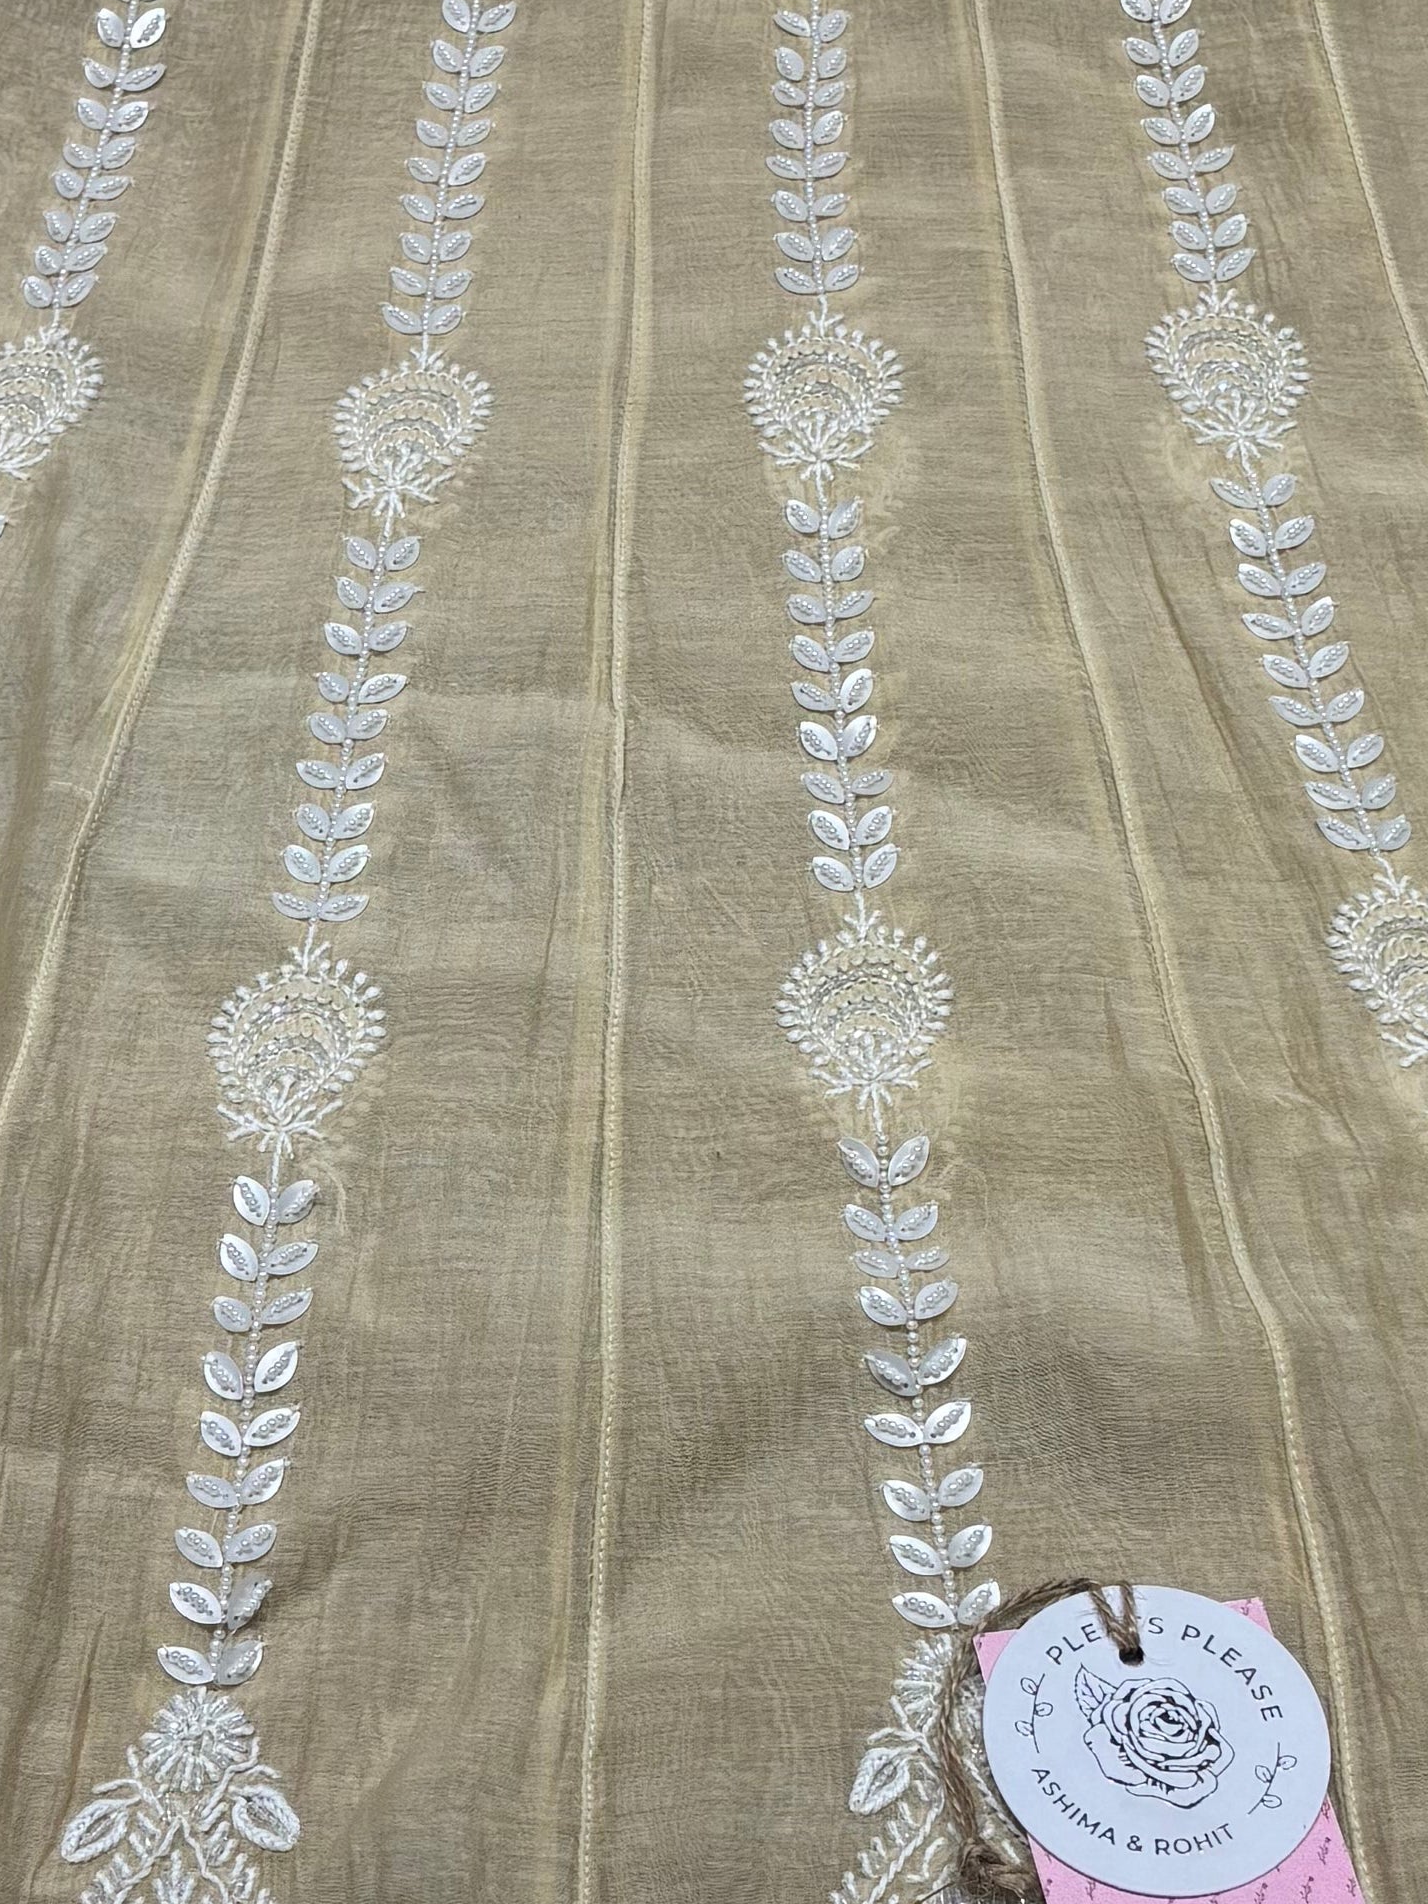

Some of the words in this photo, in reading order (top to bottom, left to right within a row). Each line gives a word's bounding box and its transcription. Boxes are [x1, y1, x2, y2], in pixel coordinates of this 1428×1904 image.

[1045, 1616, 1165, 1666] PLES
[1180, 1624, 1284, 1722] PLEASE
[1031, 1768, 1116, 1845] ASHIMA
[1126, 1835, 1143, 1852] &
[1154, 1823, 1234, 1856] ROHIT
